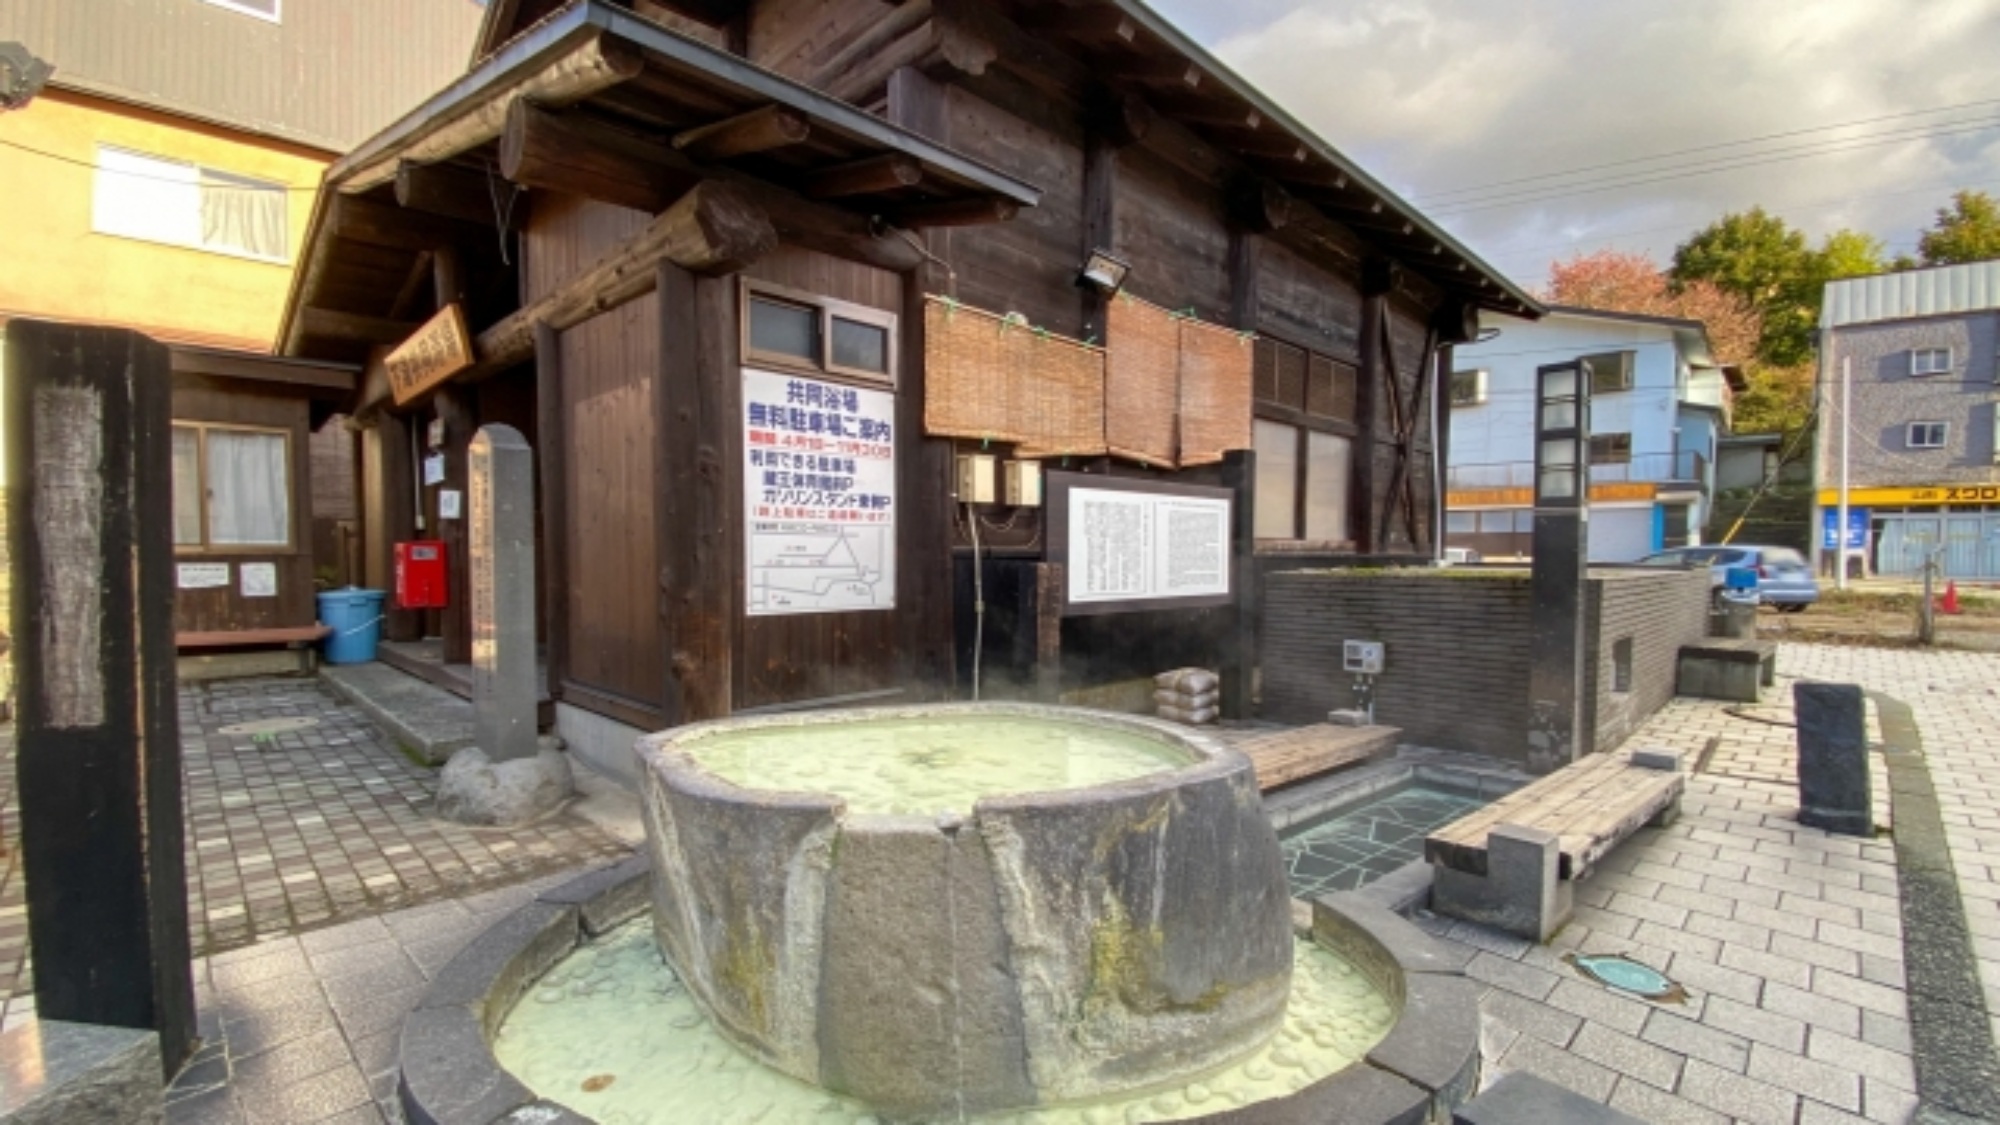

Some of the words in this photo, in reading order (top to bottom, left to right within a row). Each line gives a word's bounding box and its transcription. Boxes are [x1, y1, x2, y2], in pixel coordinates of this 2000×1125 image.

[787, 380, 858, 412] 共同浴場
[749, 403, 891, 441] 無料駐車場ご案内
